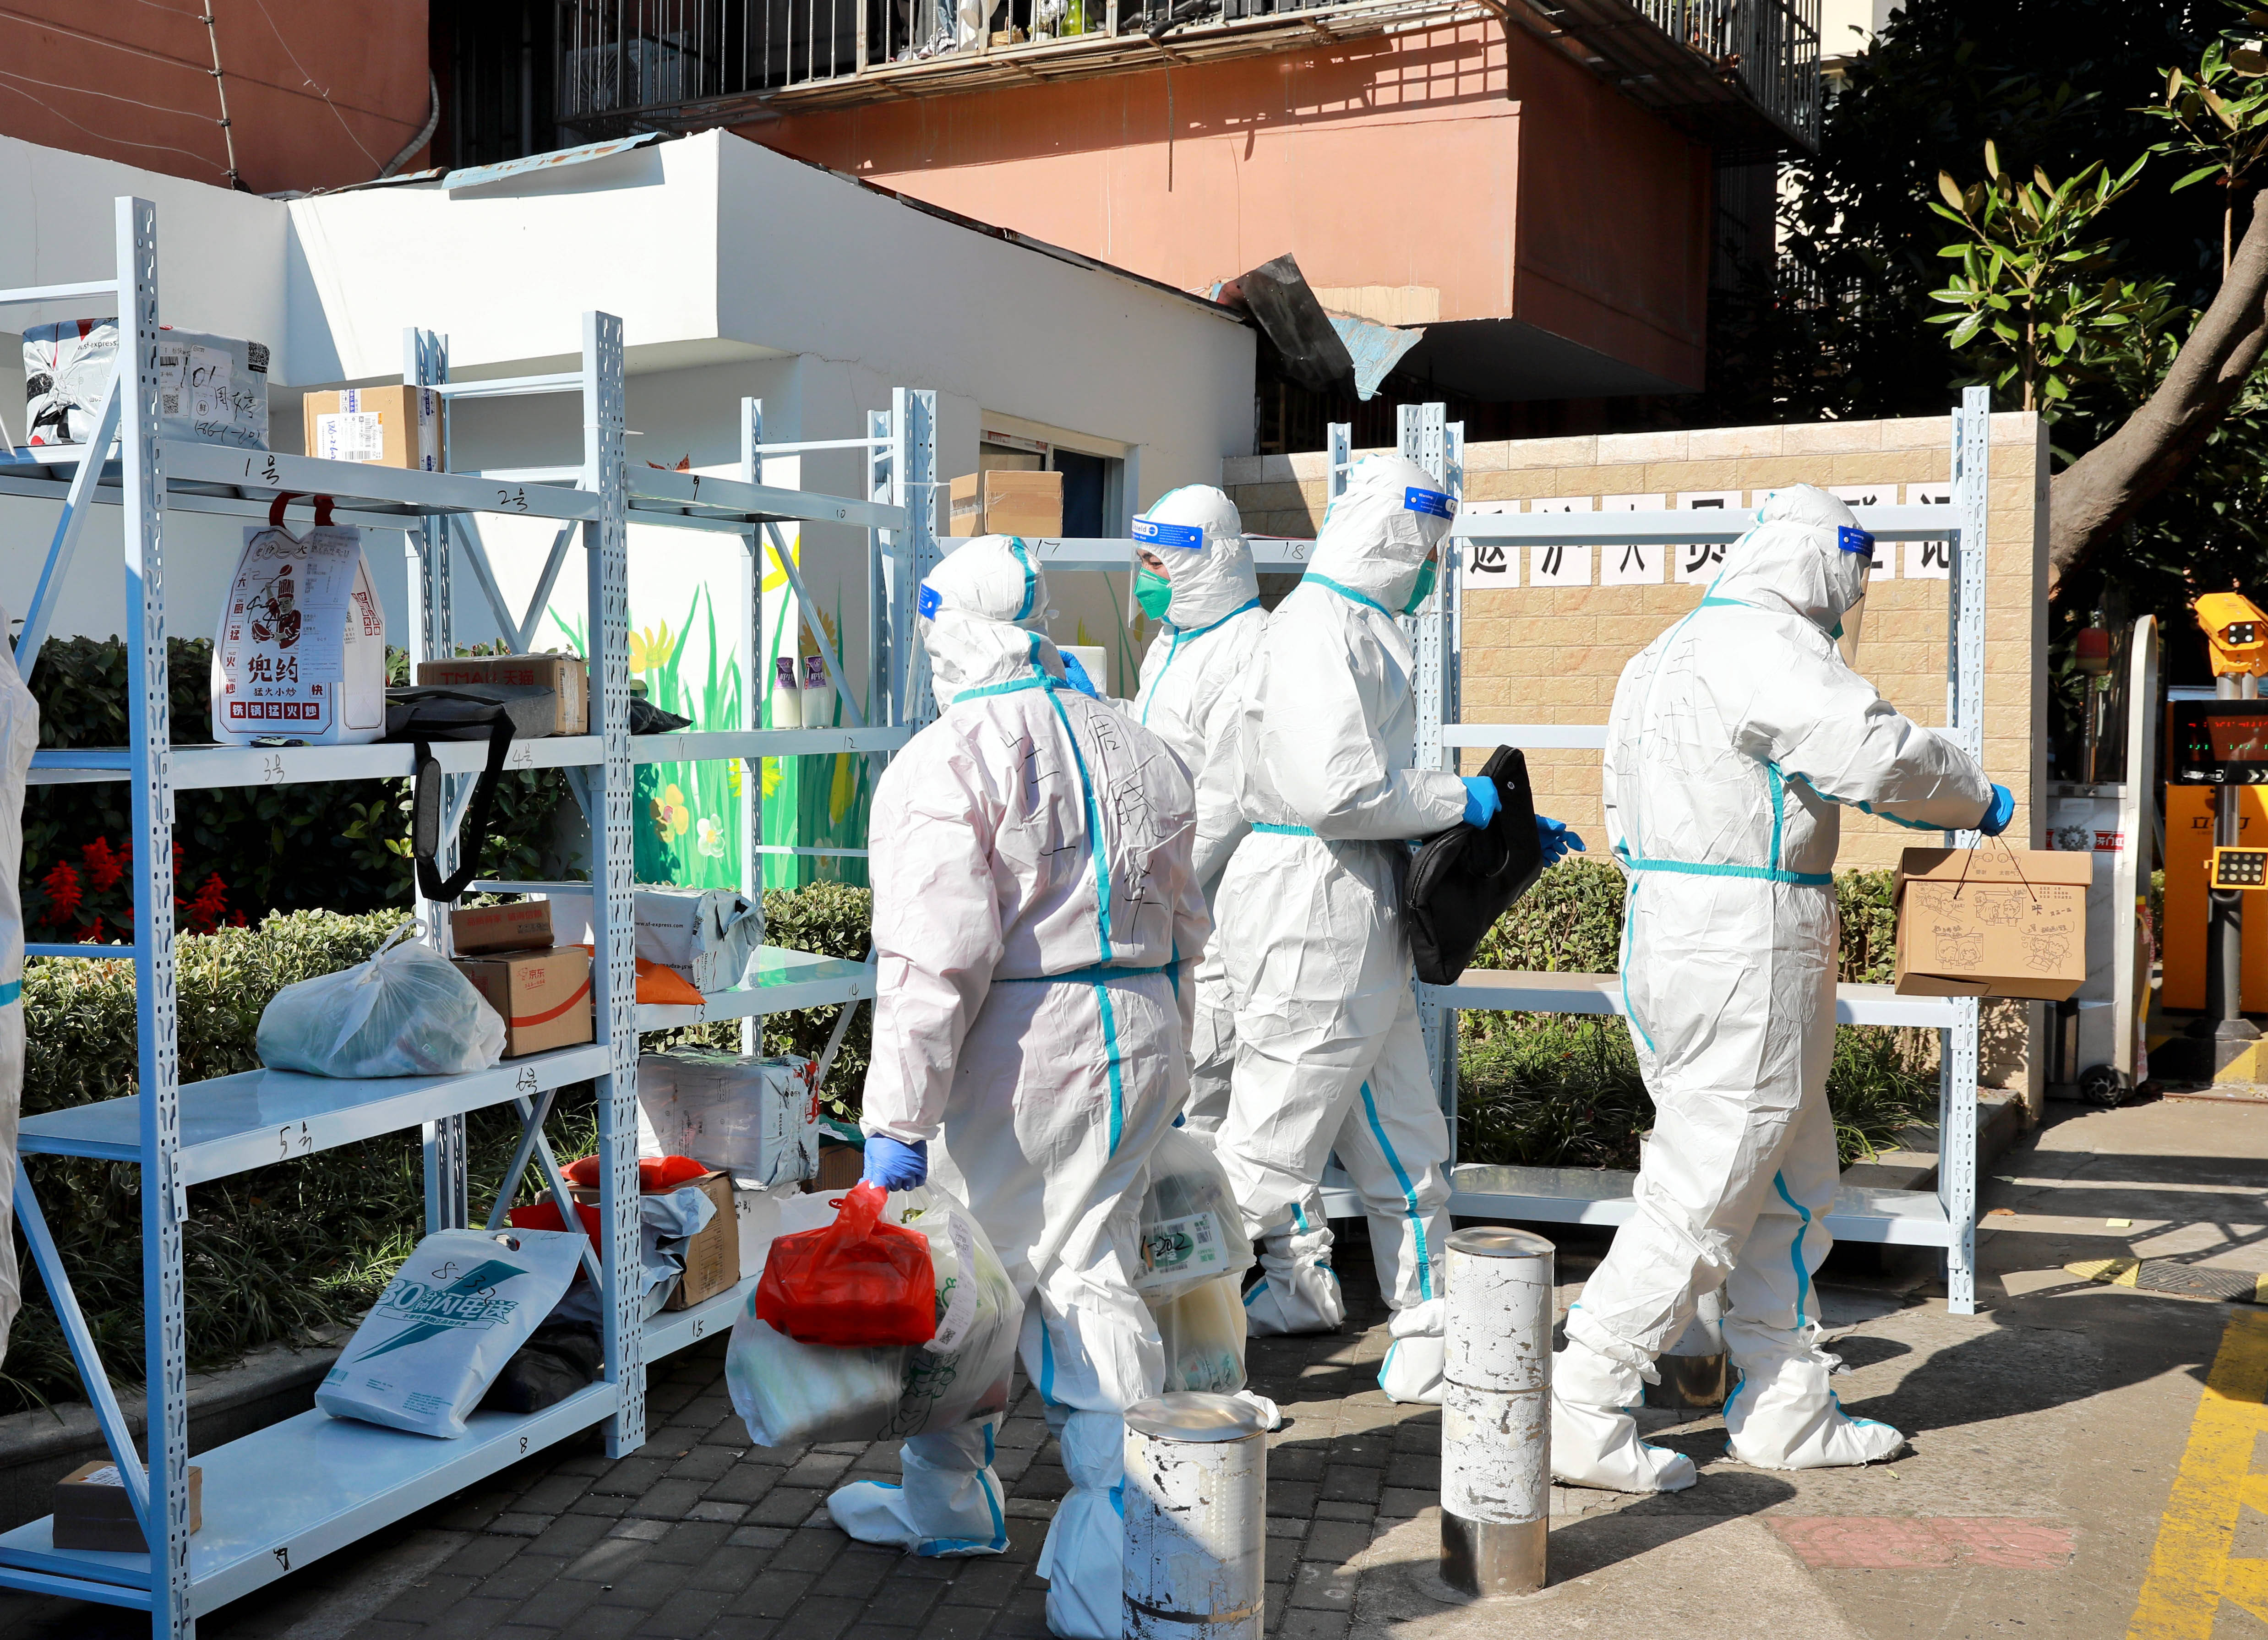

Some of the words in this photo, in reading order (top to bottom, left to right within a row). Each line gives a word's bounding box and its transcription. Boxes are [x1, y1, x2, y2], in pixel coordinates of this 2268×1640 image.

[245, 455, 279, 485] 1号
[497, 487, 528, 512] 2号
[836, 508, 846, 519] 10
[1035, 539, 1061, 557] 17
[1282, 541, 1305, 560] 18
[238, 577, 246, 588] 大
[230, 630, 240, 641] 猛
[226, 656, 235, 667] 火
[247, 652, 299, 684] 兜约
[504, 670, 534, 686] 天猫
[225, 683, 235, 695] 炒
[253, 687, 297, 697] 猛火小炒
[311, 684, 323, 696] 快
[232, 703, 320, 718] 铁锅猛火炒
[843, 735, 859, 752] 12
[512, 742, 534, 769] 4号
[264, 754, 285, 784] 3号
[529, 968, 545, 980] 京东
[848, 982, 860, 1001] 14
[693, 1003, 706, 1023] 13
[516, 1067, 538, 1094] 6号
[279, 1121, 312, 1160] 5号
[1140, 1231, 1193, 1260] 1-202
[692, 1319, 704, 1337] 15
[519, 1437, 528, 1454] 8
